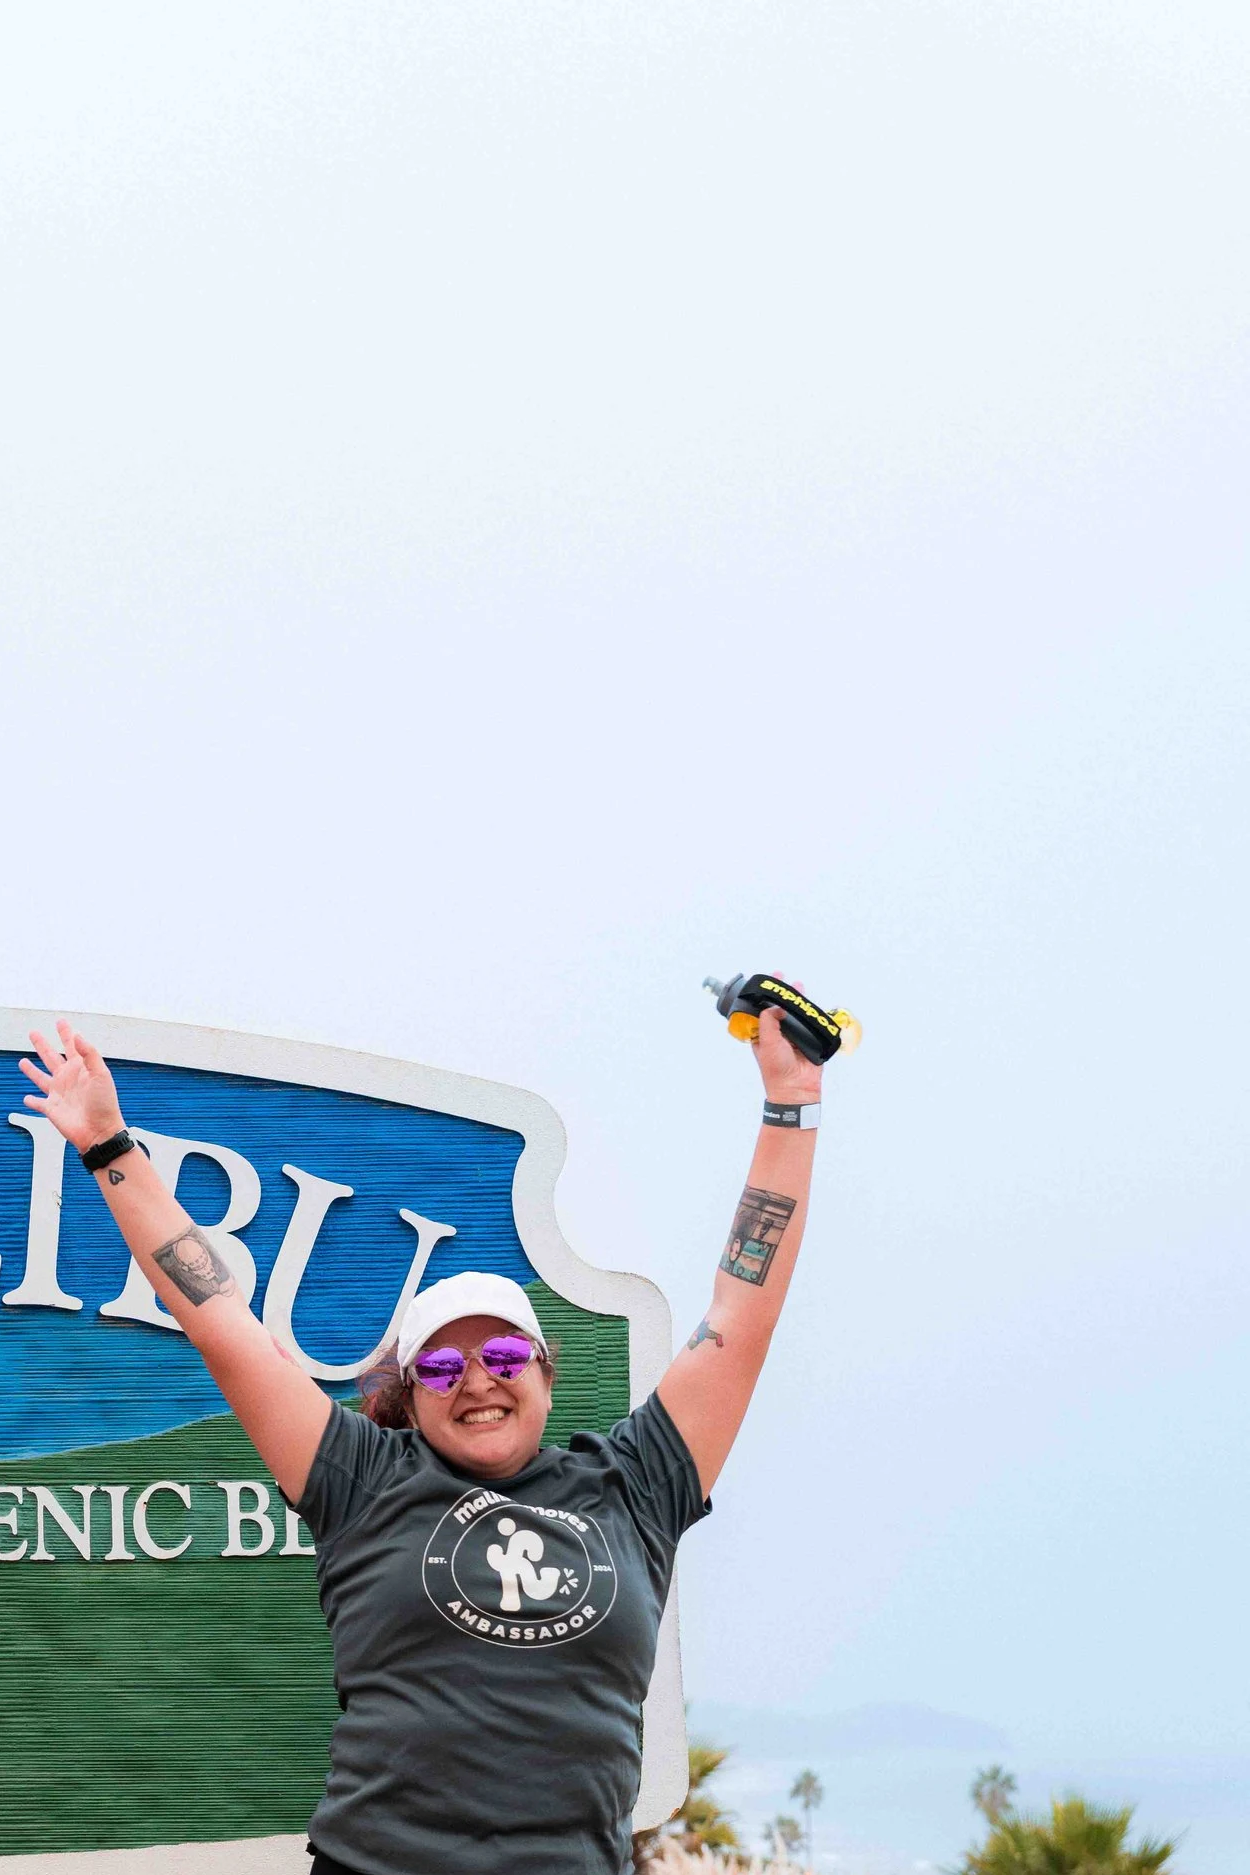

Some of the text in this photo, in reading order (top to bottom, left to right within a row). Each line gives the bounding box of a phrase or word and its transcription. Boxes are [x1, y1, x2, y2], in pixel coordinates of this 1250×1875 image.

[760, 979, 840, 1037] amphipod
[428, 1556, 448, 1565] EST.
[446, 1600, 597, 1641] AMBASSADOR
